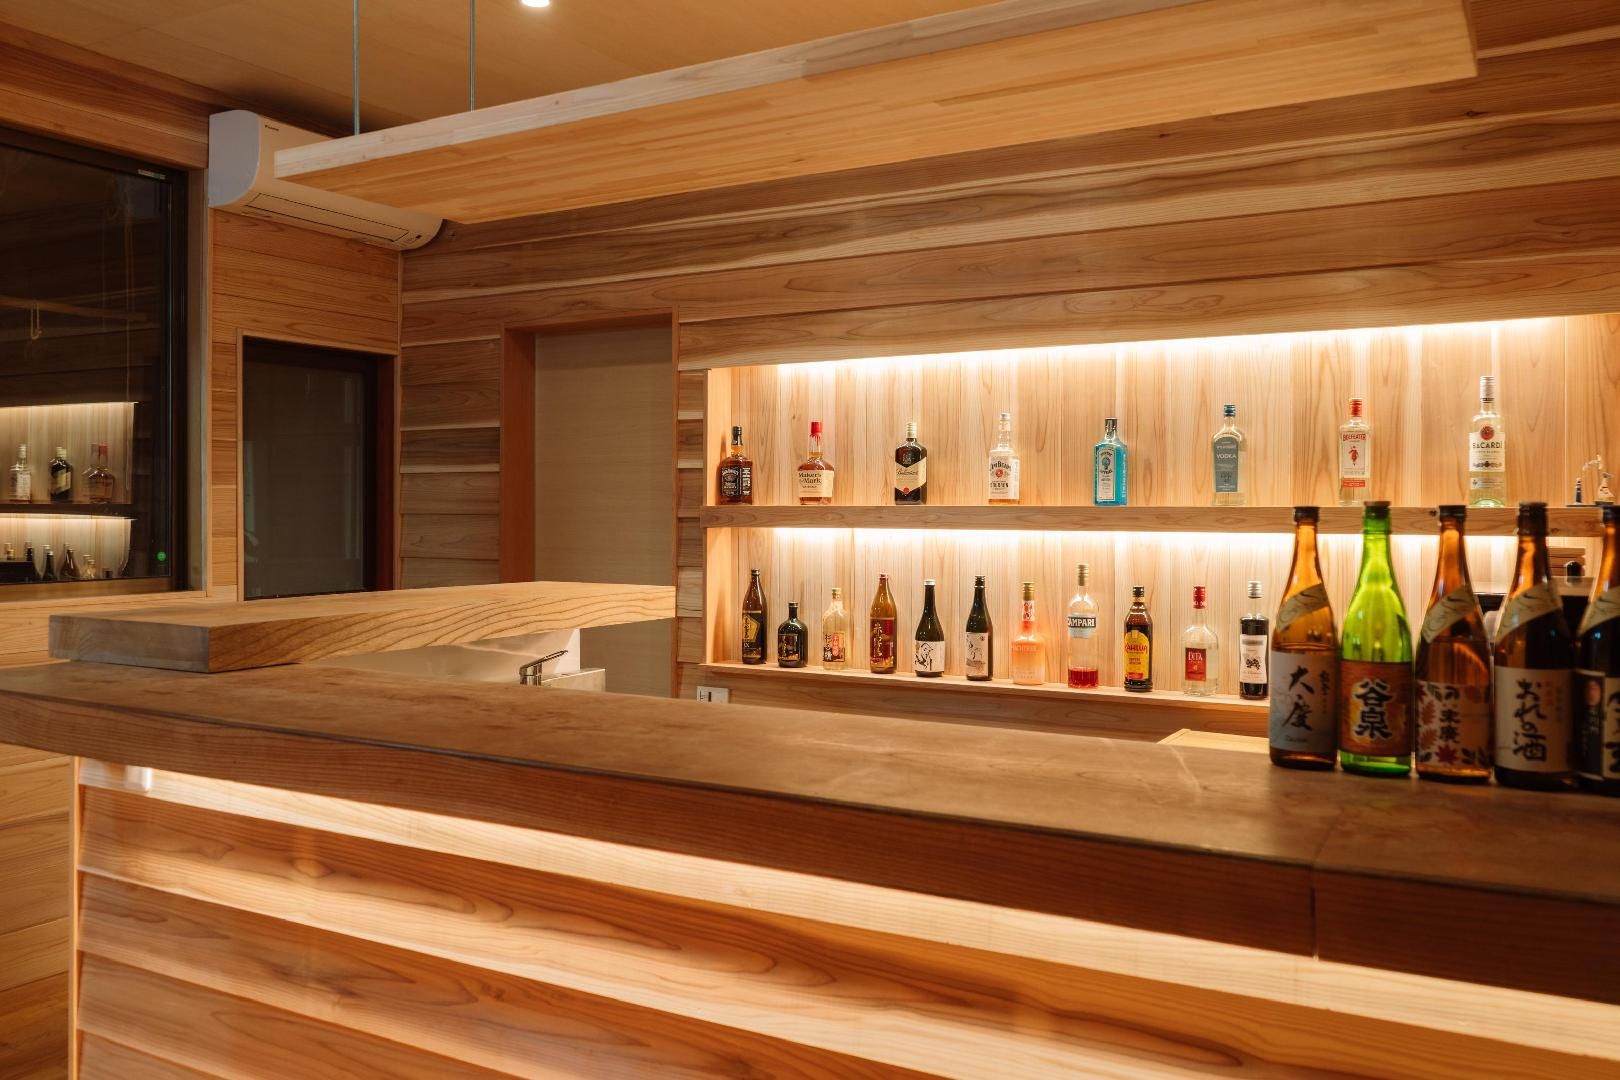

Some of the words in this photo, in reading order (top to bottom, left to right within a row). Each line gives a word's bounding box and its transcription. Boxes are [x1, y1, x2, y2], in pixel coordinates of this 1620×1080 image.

[1354, 680, 1394, 740] 谷泉
[1513, 679, 1549, 762] おれの酒
